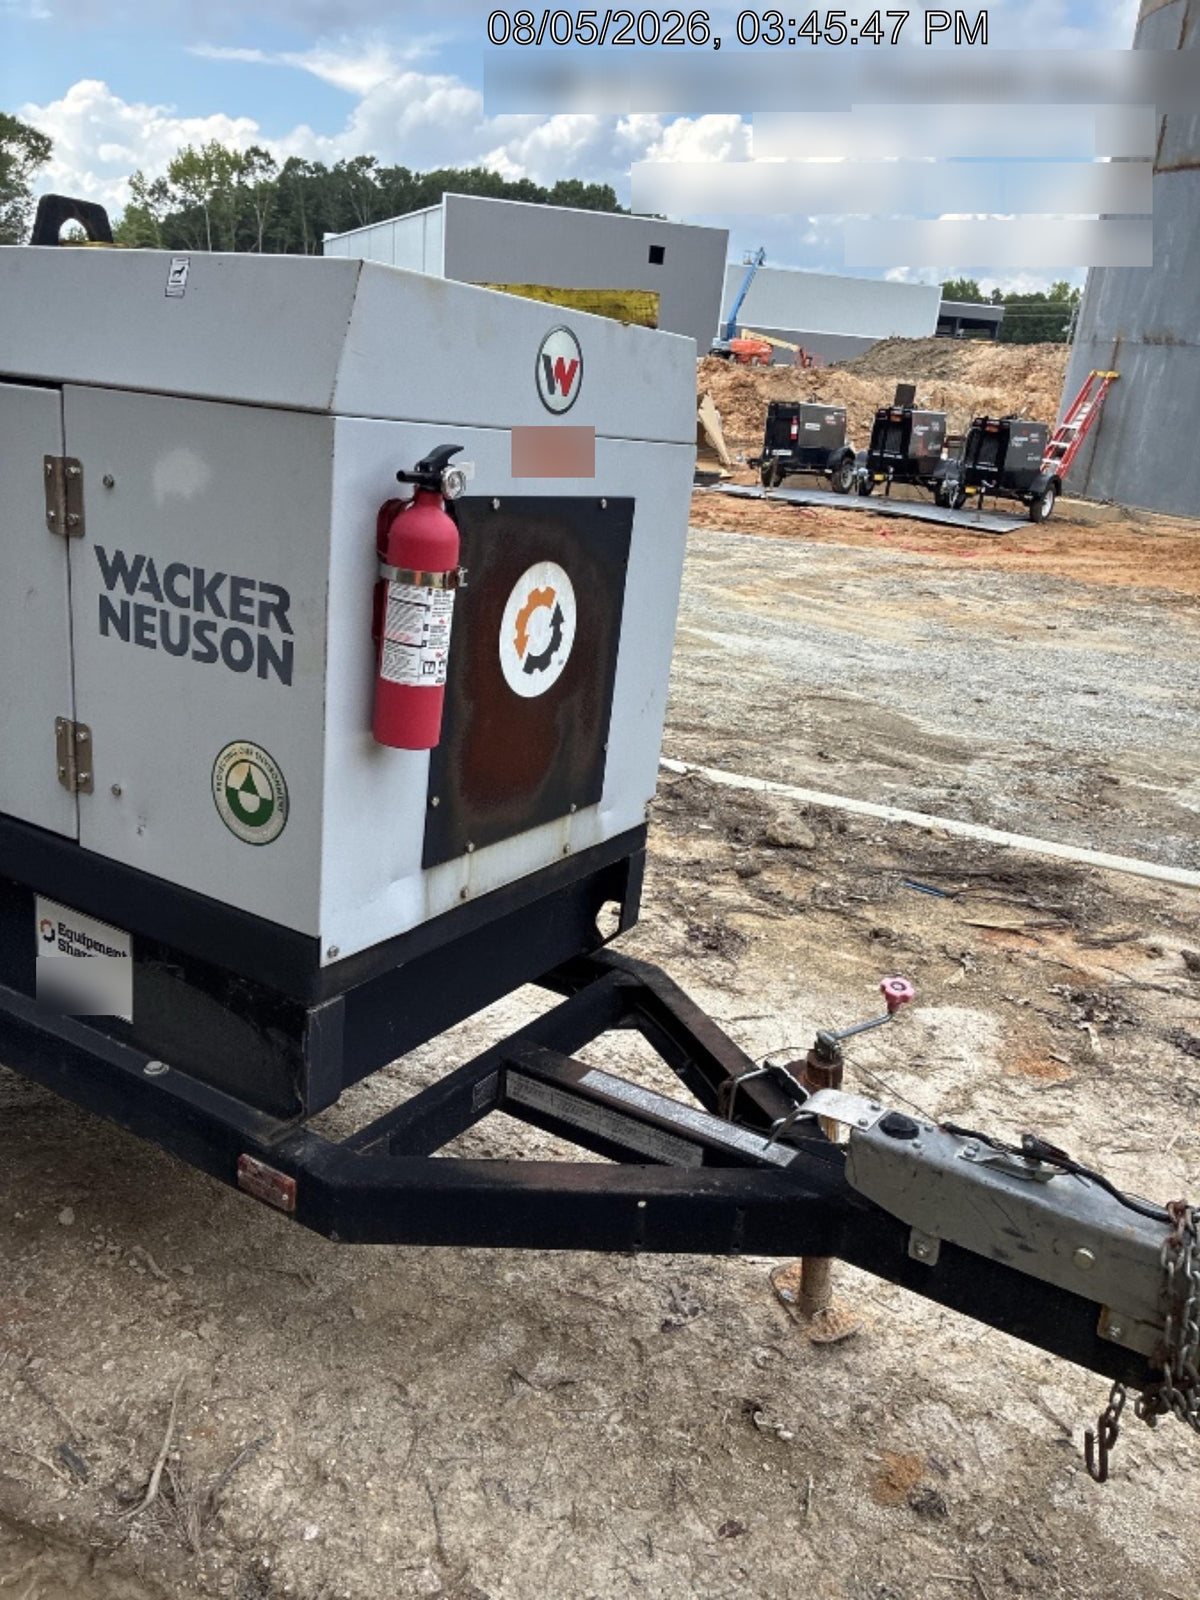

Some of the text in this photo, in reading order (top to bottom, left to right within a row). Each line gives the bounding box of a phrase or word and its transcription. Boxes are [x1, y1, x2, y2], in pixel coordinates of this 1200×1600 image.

[541, 353, 580, 397] W
[94, 545, 294, 635] WACKER
[99, 593, 294, 687] NEUSON
